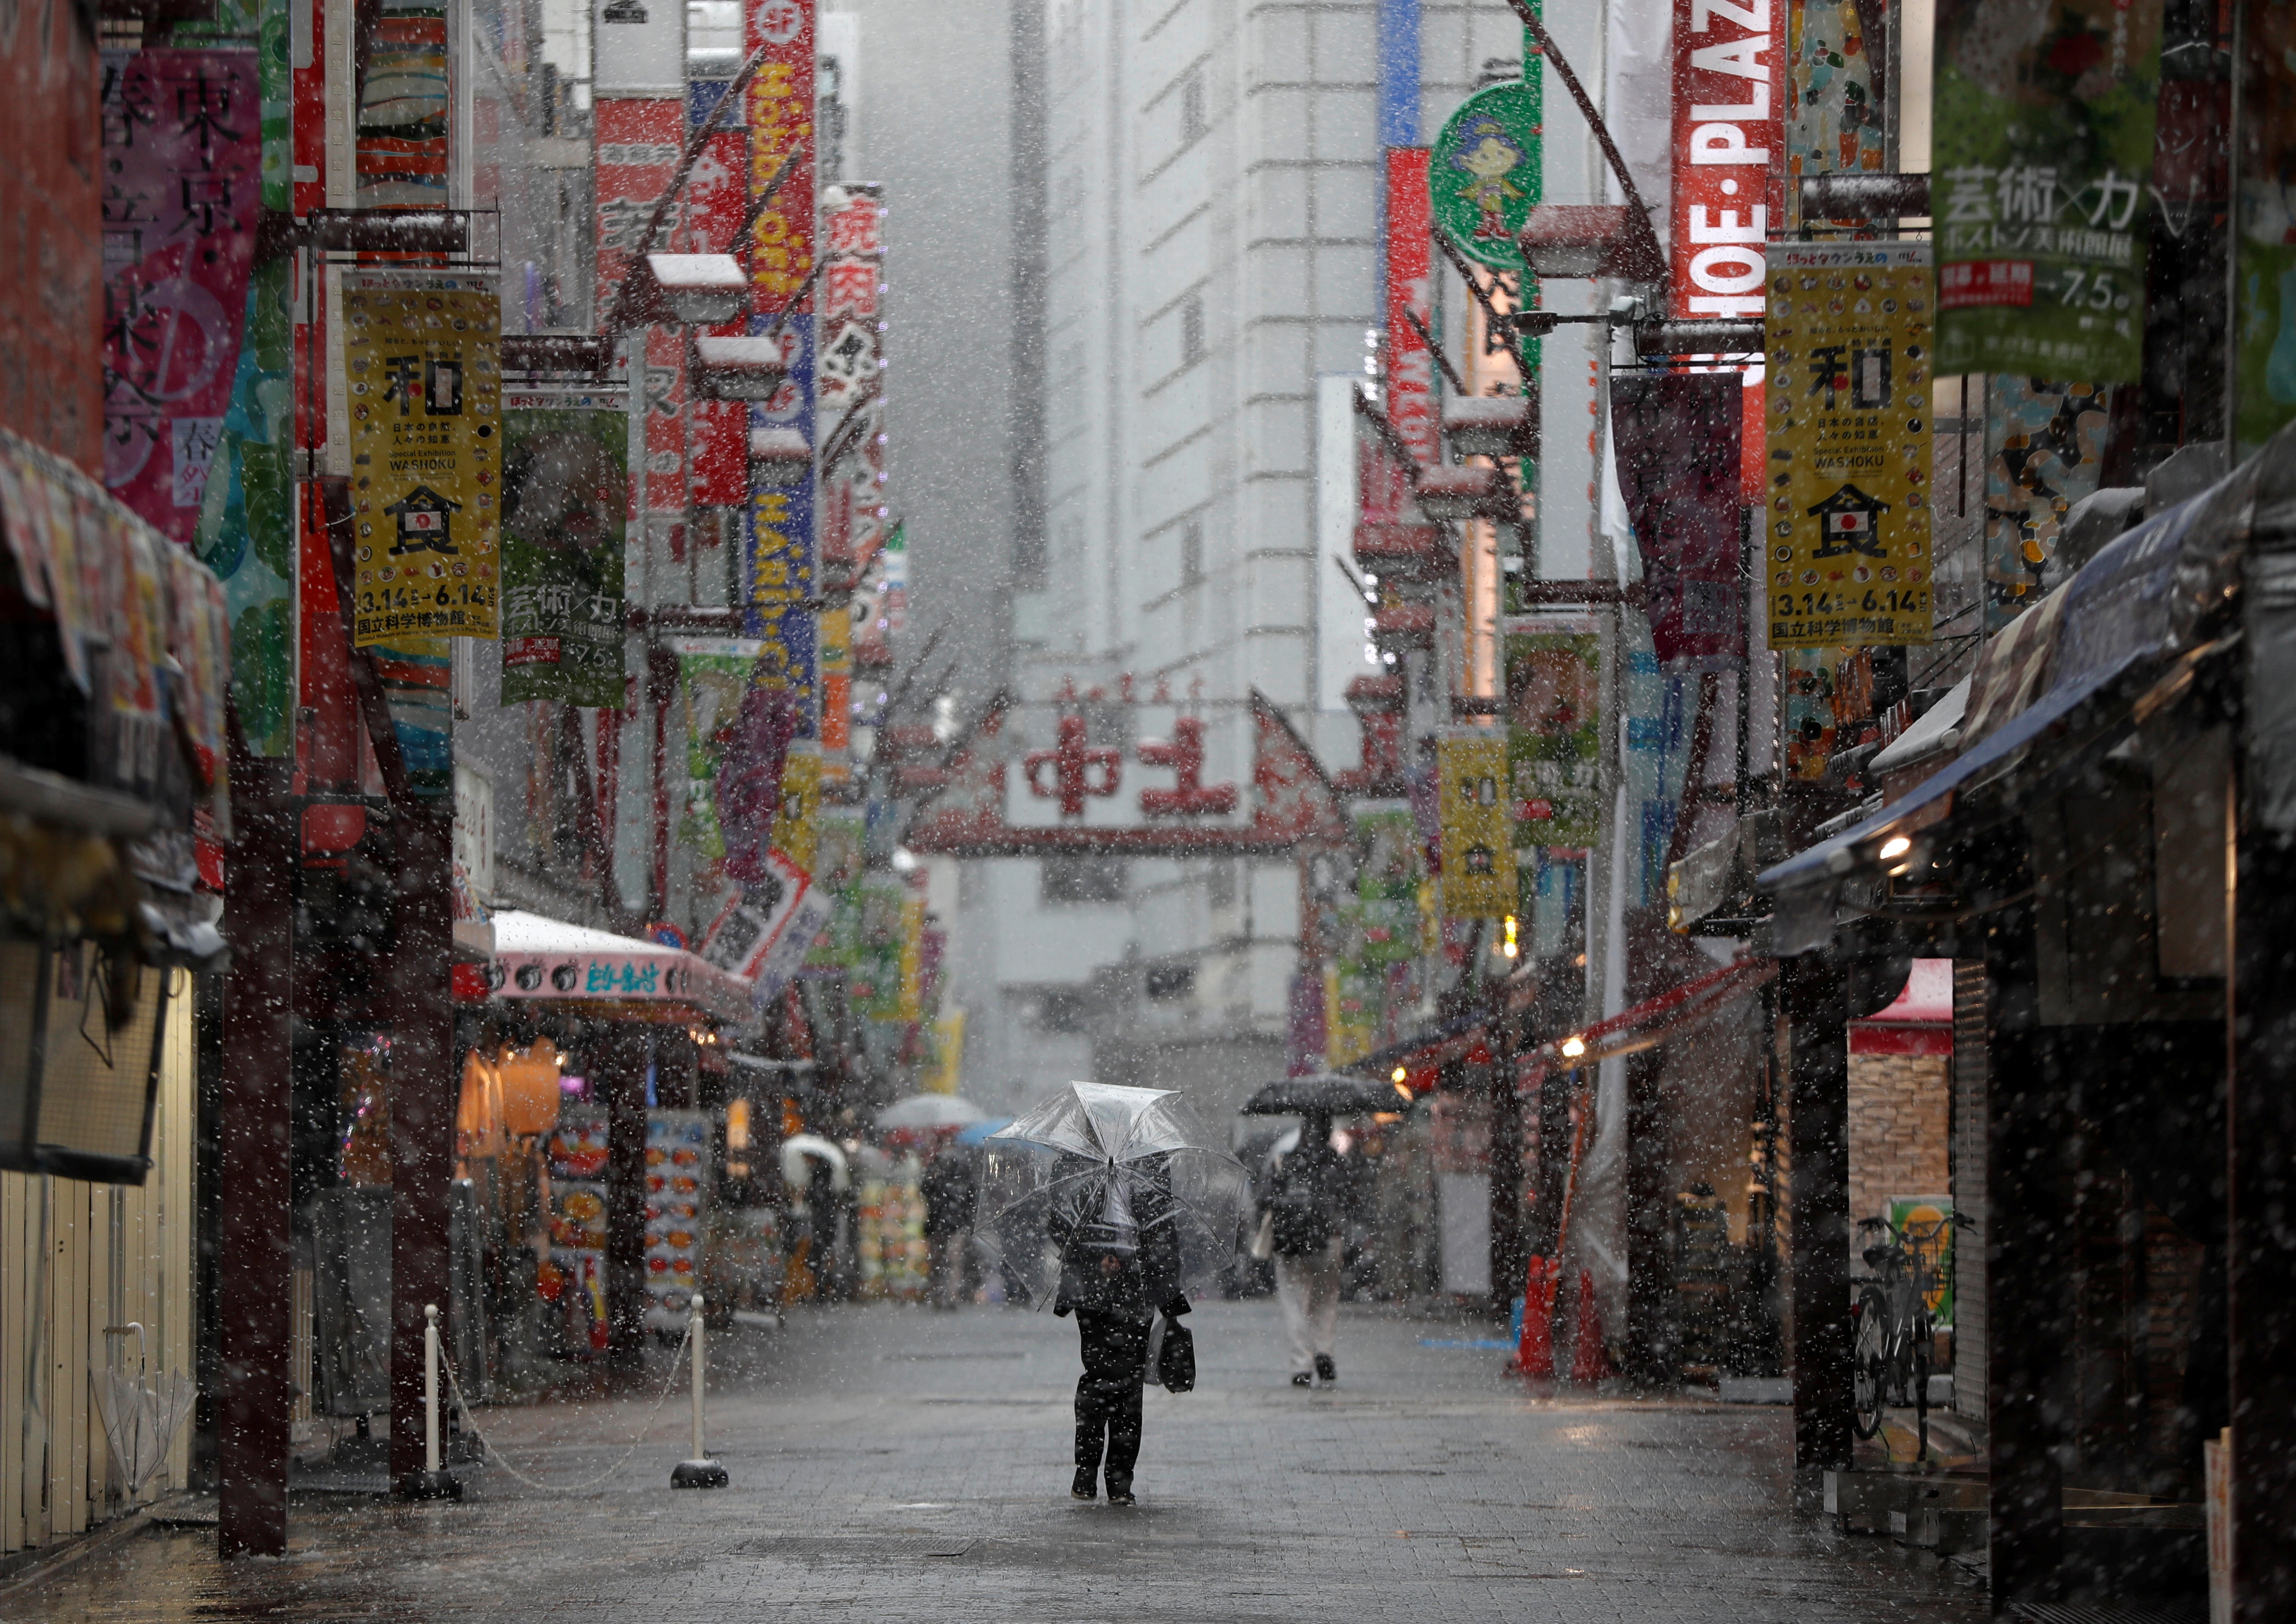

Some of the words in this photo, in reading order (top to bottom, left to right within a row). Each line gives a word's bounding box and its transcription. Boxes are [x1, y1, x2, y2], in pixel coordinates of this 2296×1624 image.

[1786, 252, 1888, 265] ほっとタウンうえの
[361, 279, 458, 290] ほっとタウンうえの
[510, 397, 592, 407] ほっとタウンうえの
[393, 421, 456, 433] 日本の自然、
[393, 435, 450, 445] 人々の知恵
[389, 450, 417, 459] Special
[418, 448, 456, 457] Exhibition
[1813, 447, 1842, 456] Special
[1844, 445, 1884, 454] Exhibition
[389, 459, 456, 471] WASHOKU
[1814, 455, 1884, 469] WASHOKU
[383, 485, 463, 556] 食
[1807, 484, 1892, 559] 食
[363, 587, 408, 613] 3.14
[435, 584, 486, 606] 6.14
[1778, 592, 1833, 616] 3.14
[1861, 589, 1916, 613] 6.14
[358, 610, 466, 636] 国立科学博物館
[1772, 617, 1894, 638] 国立科学博物館
[358, 633, 375, 642] National
